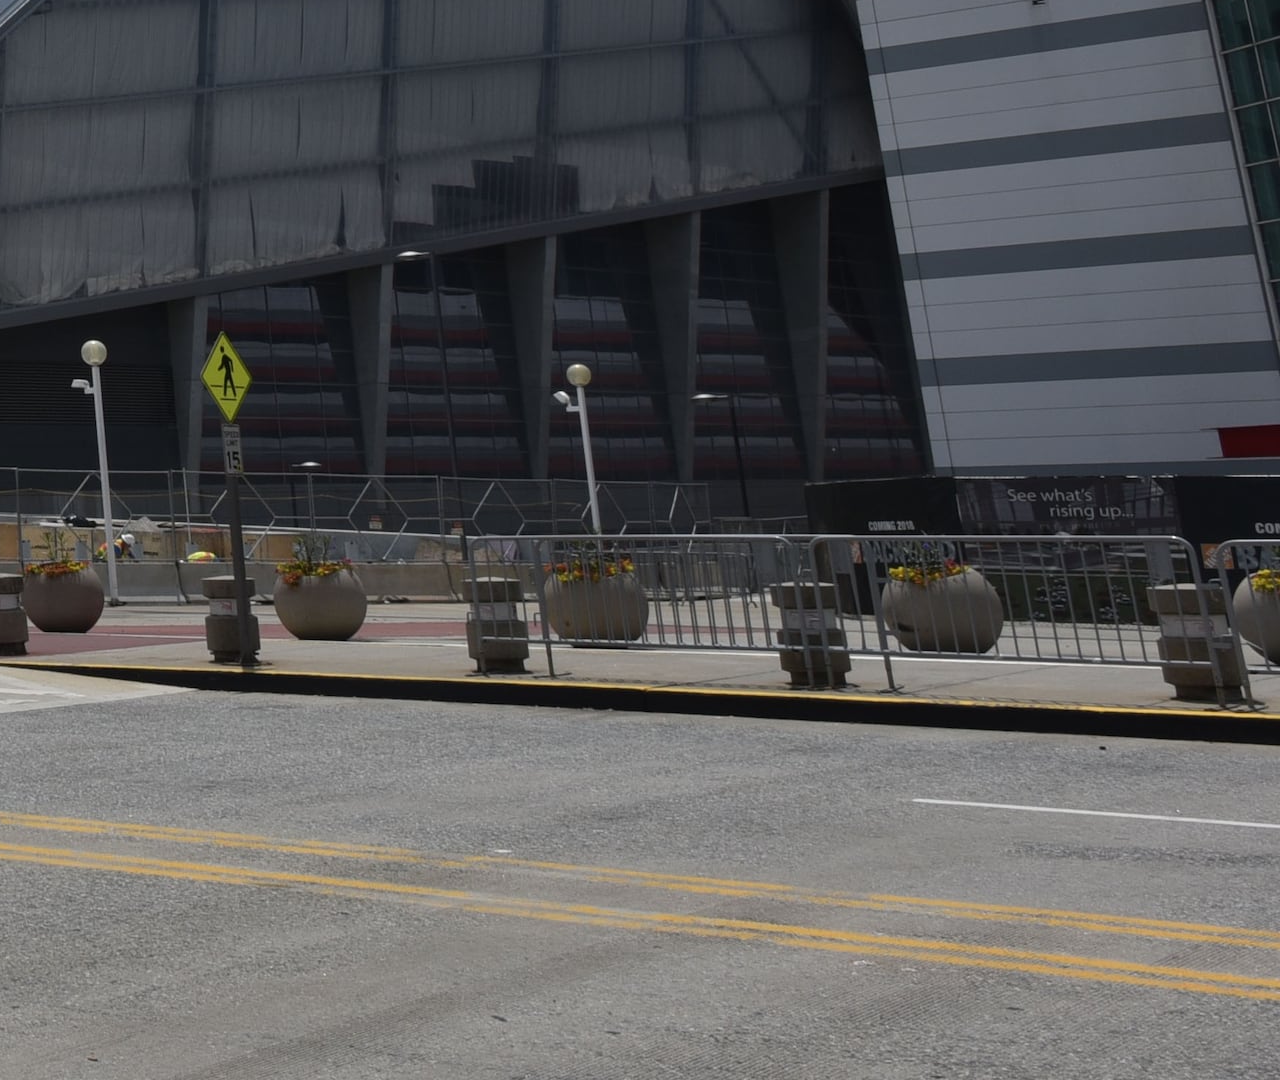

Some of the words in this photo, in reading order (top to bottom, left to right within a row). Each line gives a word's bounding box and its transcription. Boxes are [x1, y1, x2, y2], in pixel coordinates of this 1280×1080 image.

[227, 451, 241, 470] 15
[1007, 488, 1037, 502] See
[1040, 487, 1093, 502] what's
[1049, 504, 1095, 520] rising
[1099, 506, 1135, 520] up...
[868, 520, 896, 531] COMING
[896, 520, 915, 530] 2018
